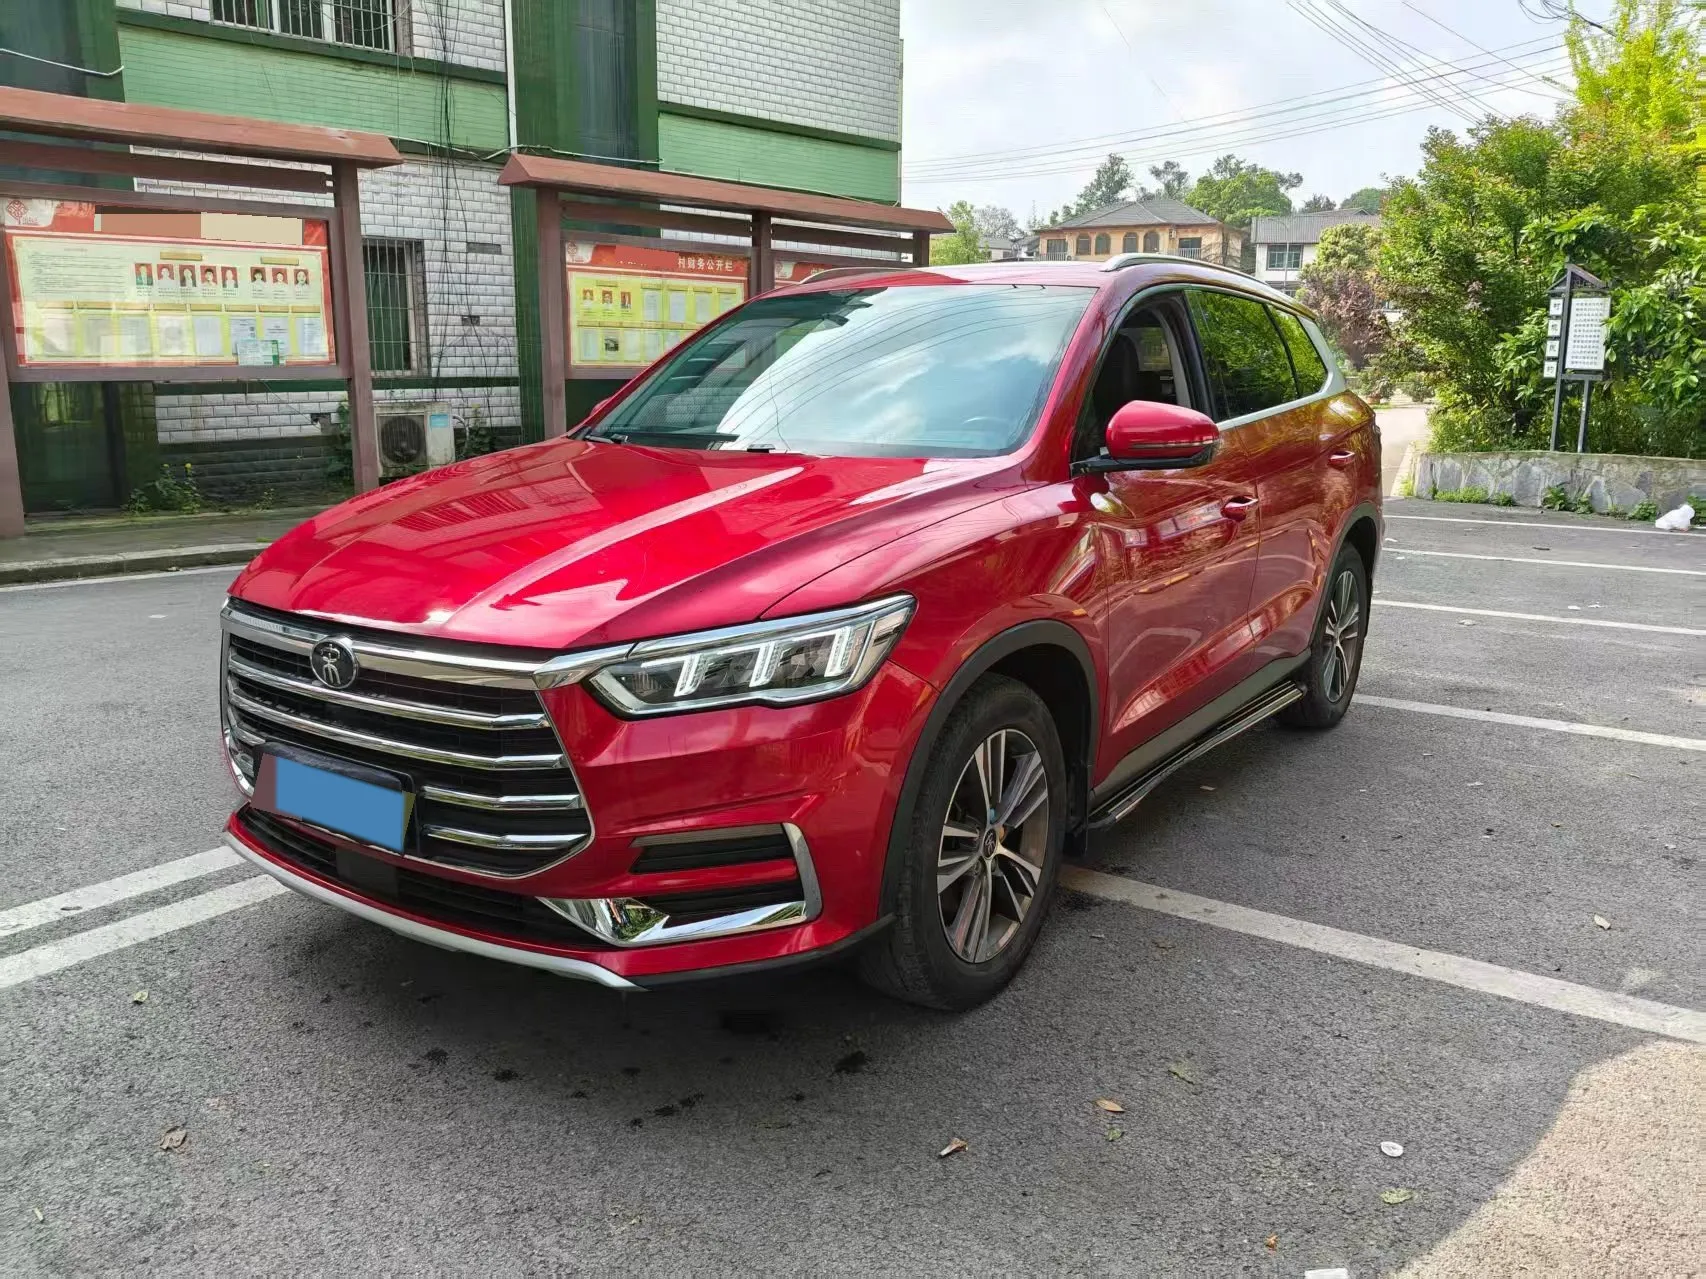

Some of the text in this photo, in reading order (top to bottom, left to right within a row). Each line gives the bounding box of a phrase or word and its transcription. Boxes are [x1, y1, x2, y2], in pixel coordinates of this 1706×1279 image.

[677, 255, 734, 272] 村财务公开栏
